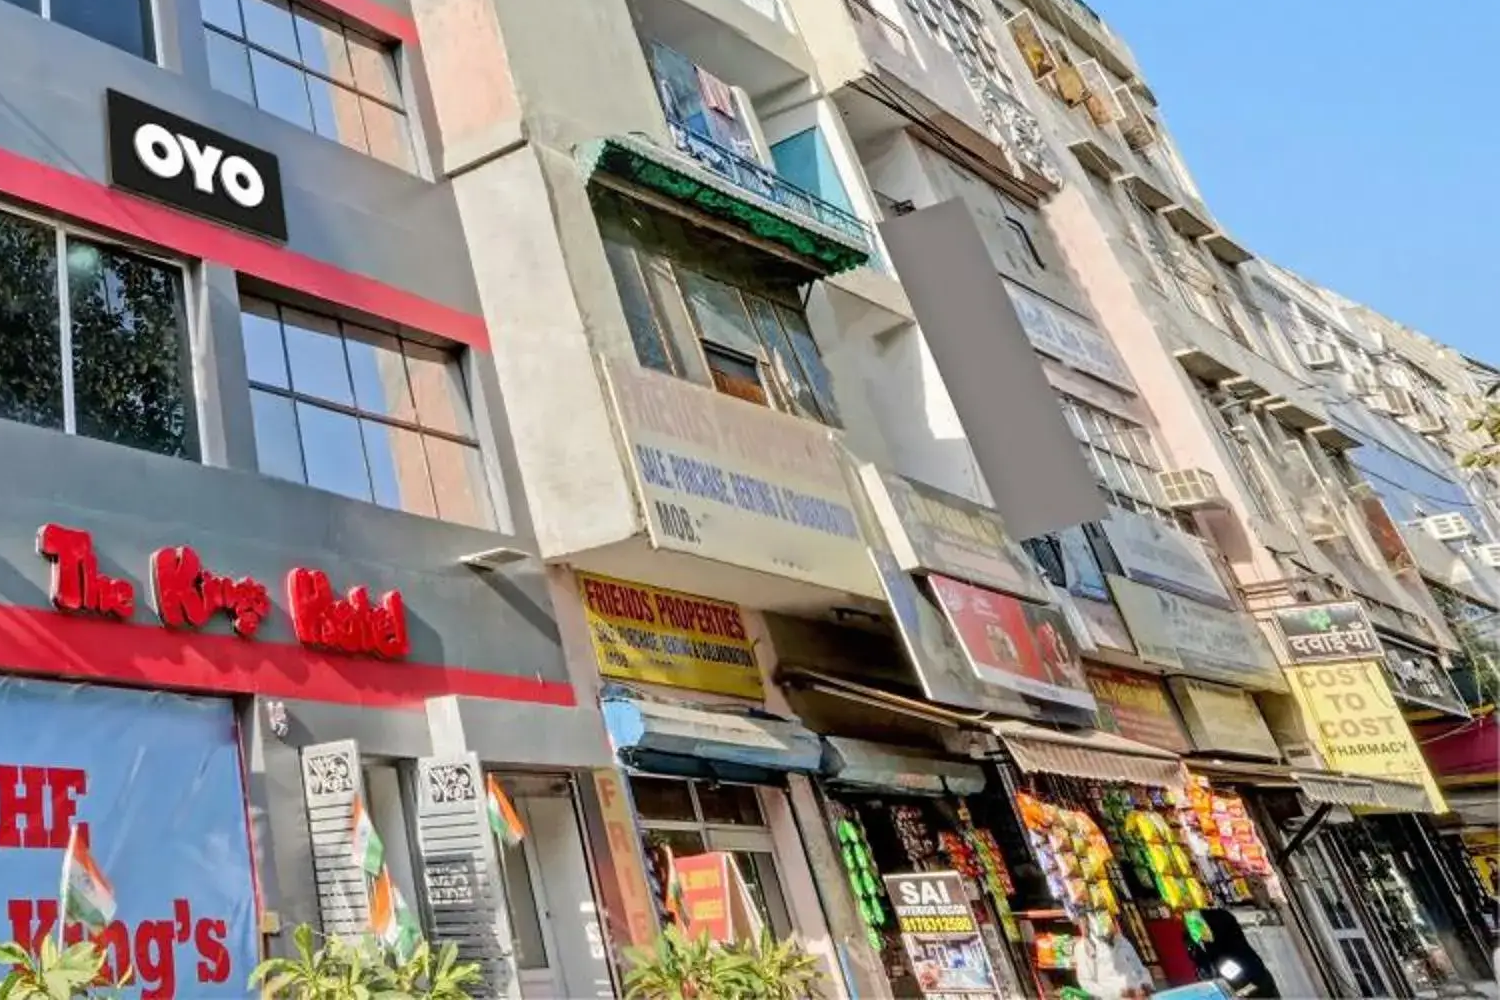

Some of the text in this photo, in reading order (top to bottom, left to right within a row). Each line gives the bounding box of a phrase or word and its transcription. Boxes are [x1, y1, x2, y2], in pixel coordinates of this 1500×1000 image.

[134, 123, 265, 207] OYO
[36, 522, 135, 618] The
[584, 578, 746, 640] FRIENDS PROPERTIES
[1298, 665, 1371, 688] COST
[1324, 692, 1366, 714] TO
[1320, 716, 1395, 739] COST
[1329, 741, 1407, 758] PHARMACY
[900, 880, 951, 905] SAI
